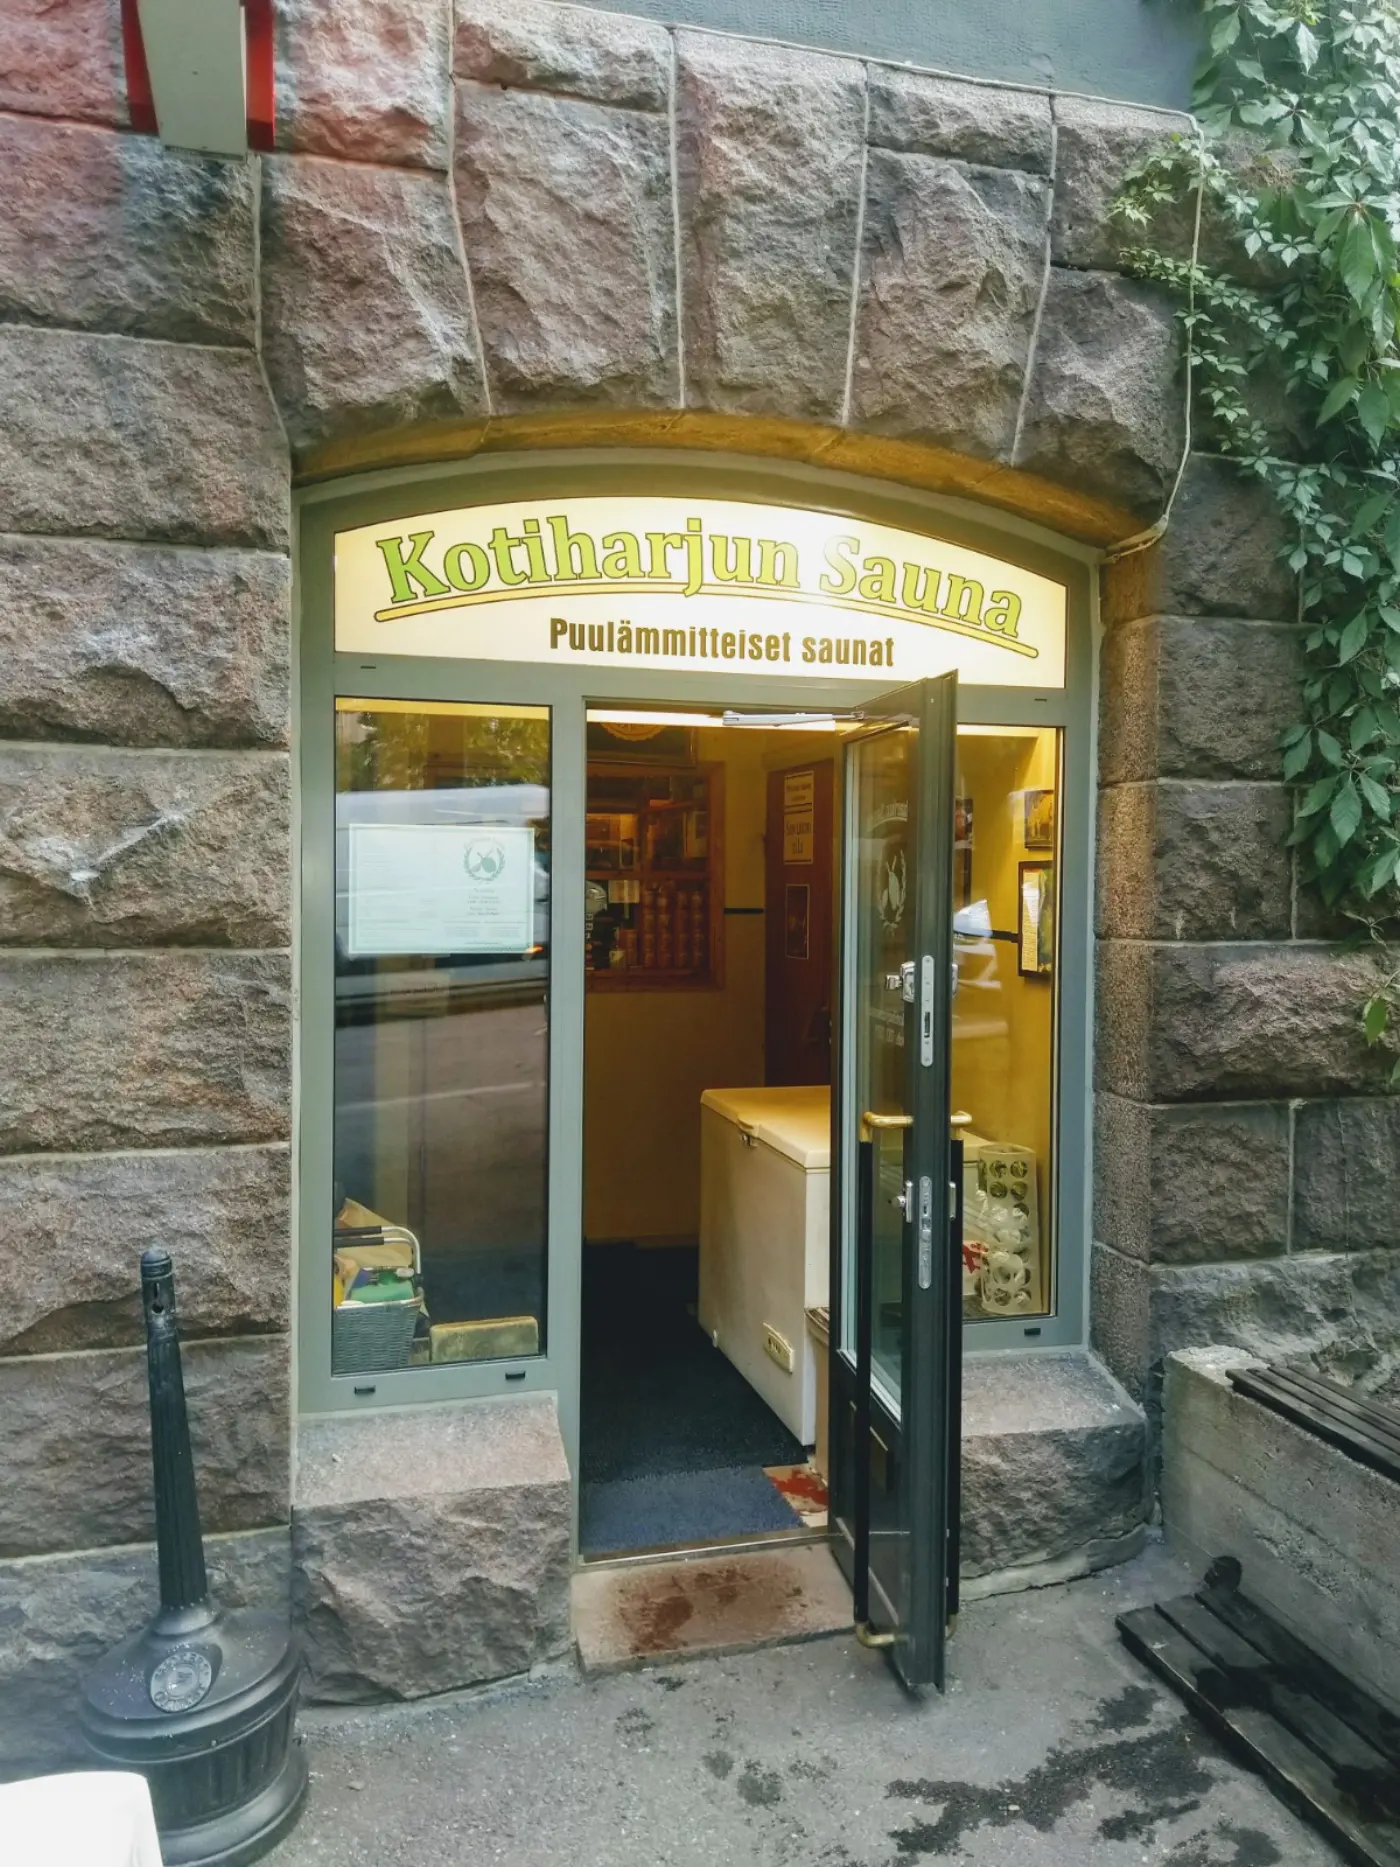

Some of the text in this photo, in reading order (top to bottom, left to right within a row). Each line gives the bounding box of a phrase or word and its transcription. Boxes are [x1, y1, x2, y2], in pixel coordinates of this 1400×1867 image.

[376, 515, 1023, 638] Kotiharjun Sauna
[550, 617, 895, 667] Puulämmitteiset saunat
